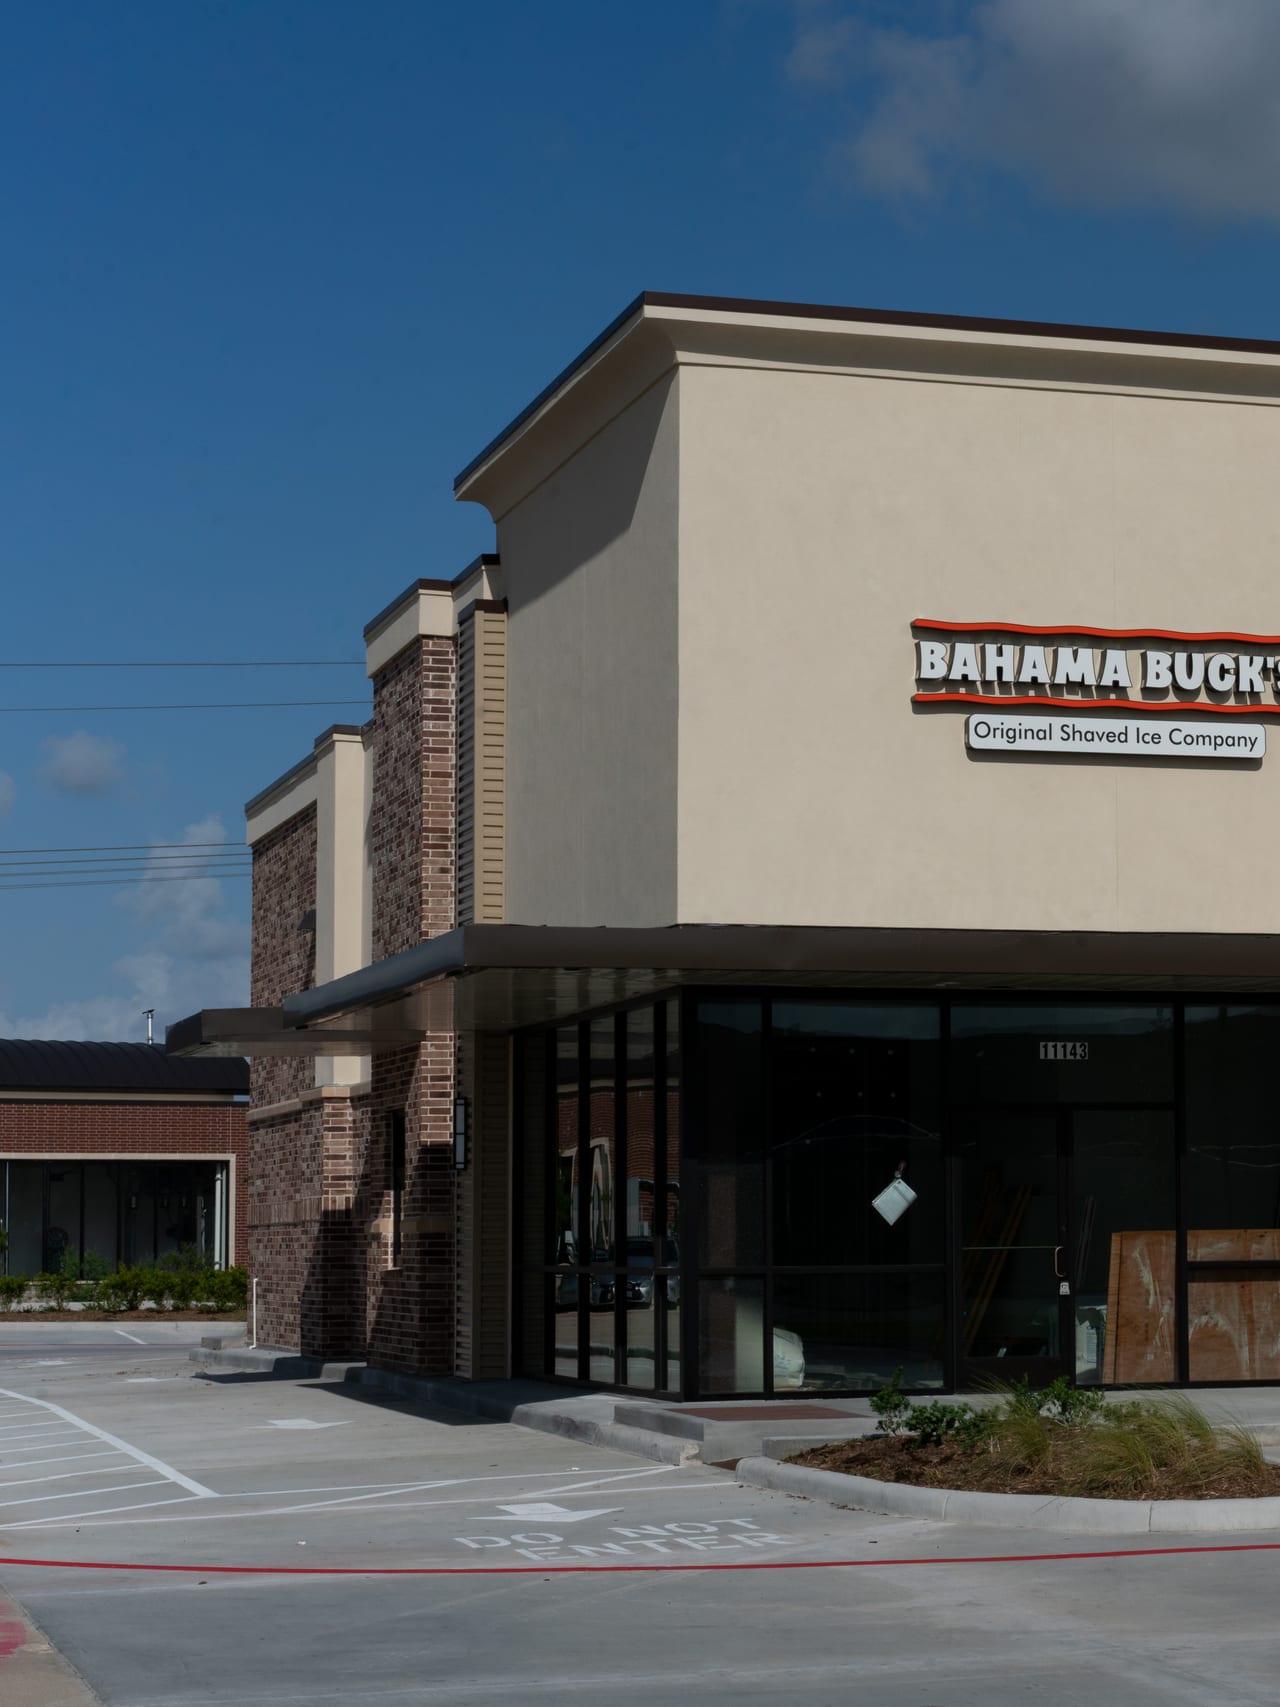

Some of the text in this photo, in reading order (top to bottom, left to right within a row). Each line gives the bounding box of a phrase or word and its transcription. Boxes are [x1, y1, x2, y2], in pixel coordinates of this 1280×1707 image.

[917, 640, 1133, 688] BAHAMA
[973, 720, 1259, 752] Original Shaved Ice Company
[1042, 1043, 1087, 1059] 11143
[453, 1518, 761, 1549] DO NOT
[515, 1532, 796, 1561] ENTER
